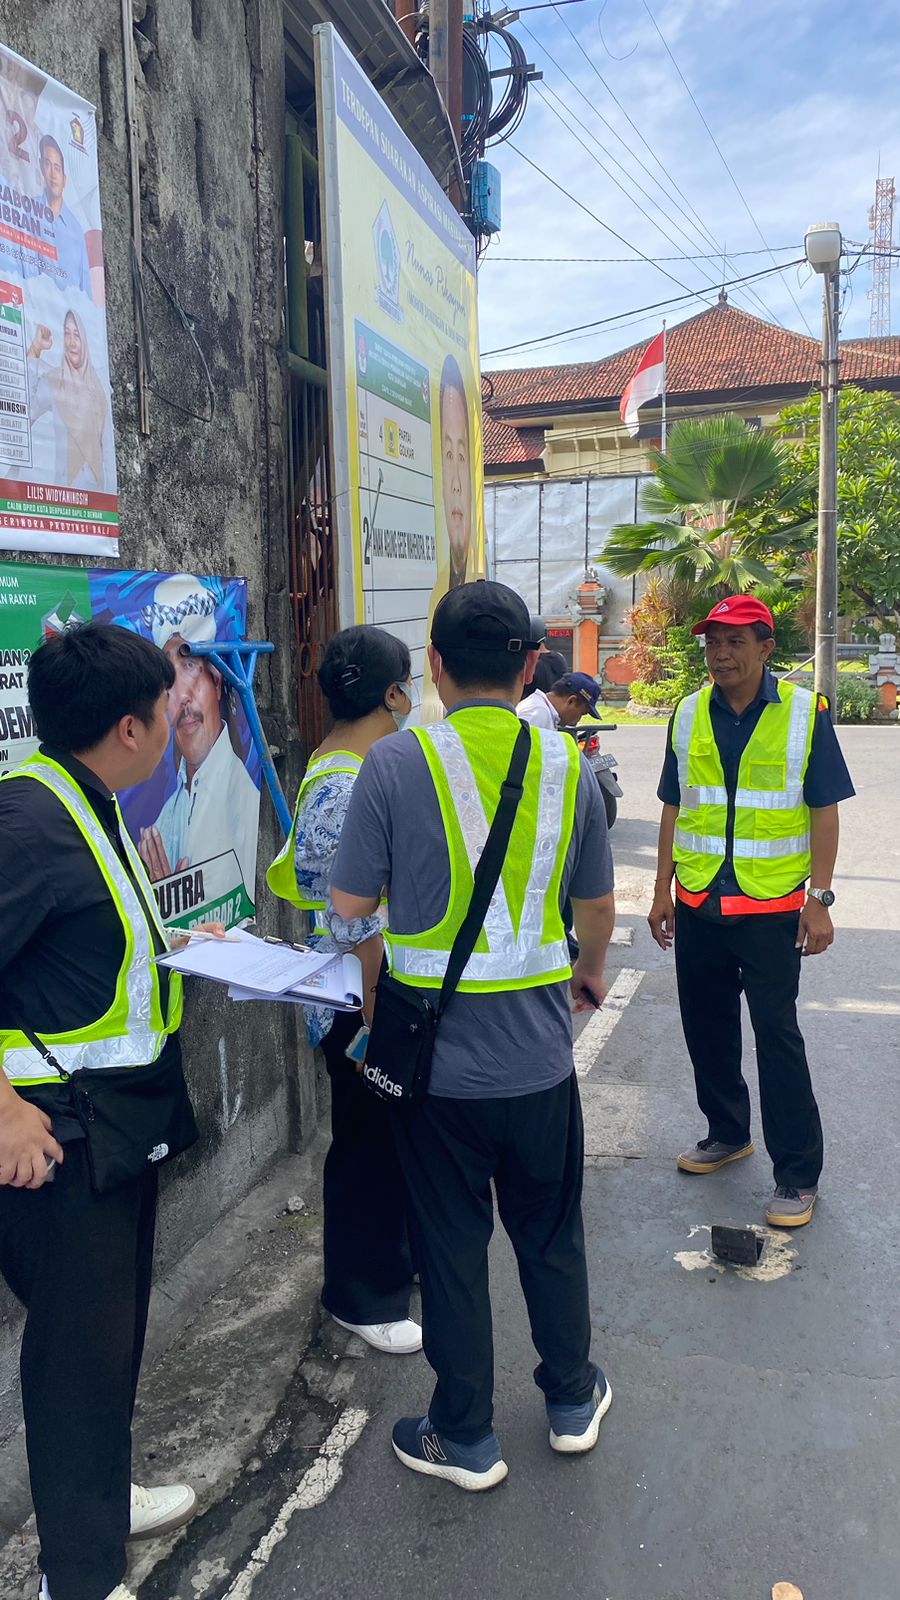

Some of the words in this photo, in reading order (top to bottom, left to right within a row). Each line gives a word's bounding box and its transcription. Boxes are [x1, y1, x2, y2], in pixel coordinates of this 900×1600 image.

[7, 110, 30, 163] 2
[341, 79, 379, 146] TERDEPAN
[380, 132, 416, 192] SUARAKAN
[399, 444, 415, 461] GOLKAR
[27, 485, 44, 501] LILIS
[49, 521, 89, 533] PROVINSI
[92, 525, 110, 535] BALI
[363, 516, 370, 565] 2
[9, 594, 37, 606] RAKYAT
[235, 893, 242, 919] 2
